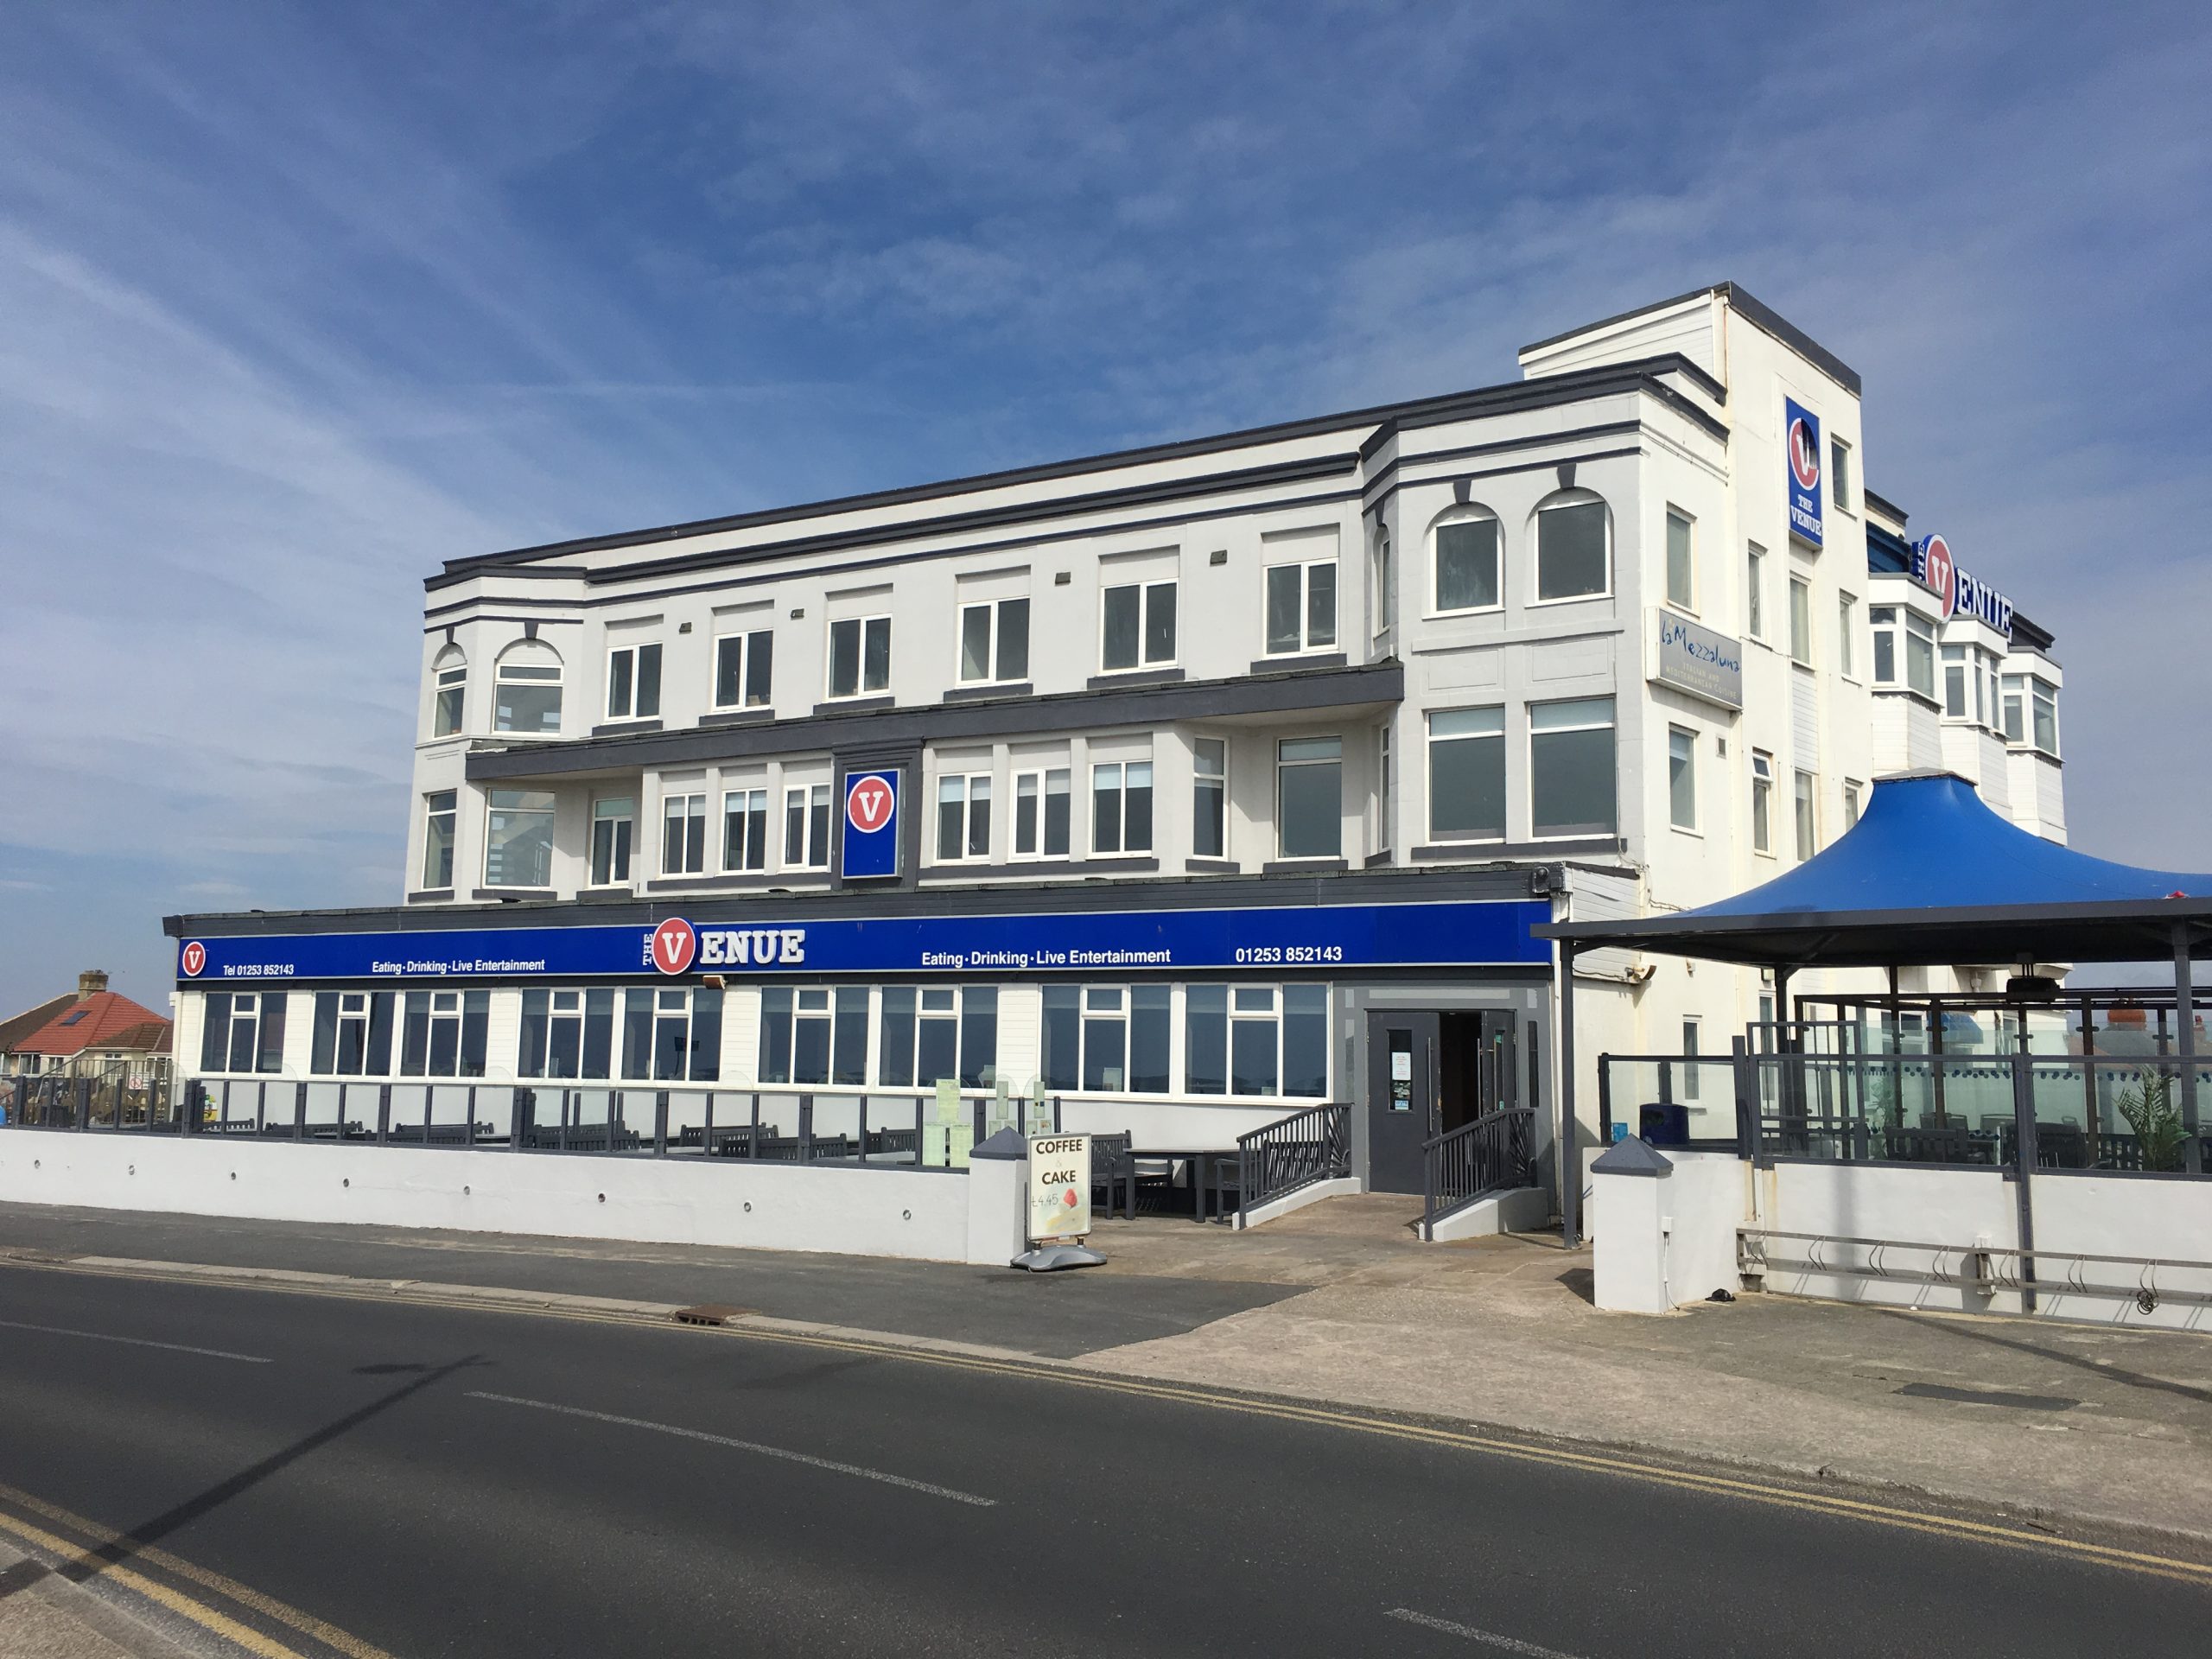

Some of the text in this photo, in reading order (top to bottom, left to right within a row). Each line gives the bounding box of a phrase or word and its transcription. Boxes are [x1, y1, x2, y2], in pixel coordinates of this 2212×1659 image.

[1797, 493, 1814, 513] THE
[1790, 505, 1822, 537] VENUE
[1675, 626, 1740, 672] Mezzaluna
[858, 791, 884, 822] V
[642, 933, 654, 966] THE
[922, 948, 1172, 968] Eating Drinking Live Entertainment
[1236, 946, 1343, 963] 01253 852143
[187, 950, 201, 969] V
[372, 958, 545, 975] Eating Drinking Live Entertainment
[223, 963, 295, 976] Tel 01253 852143
[1036, 1139, 1083, 1154] COFFEE
[1041, 1170, 1077, 1185] CAKE
